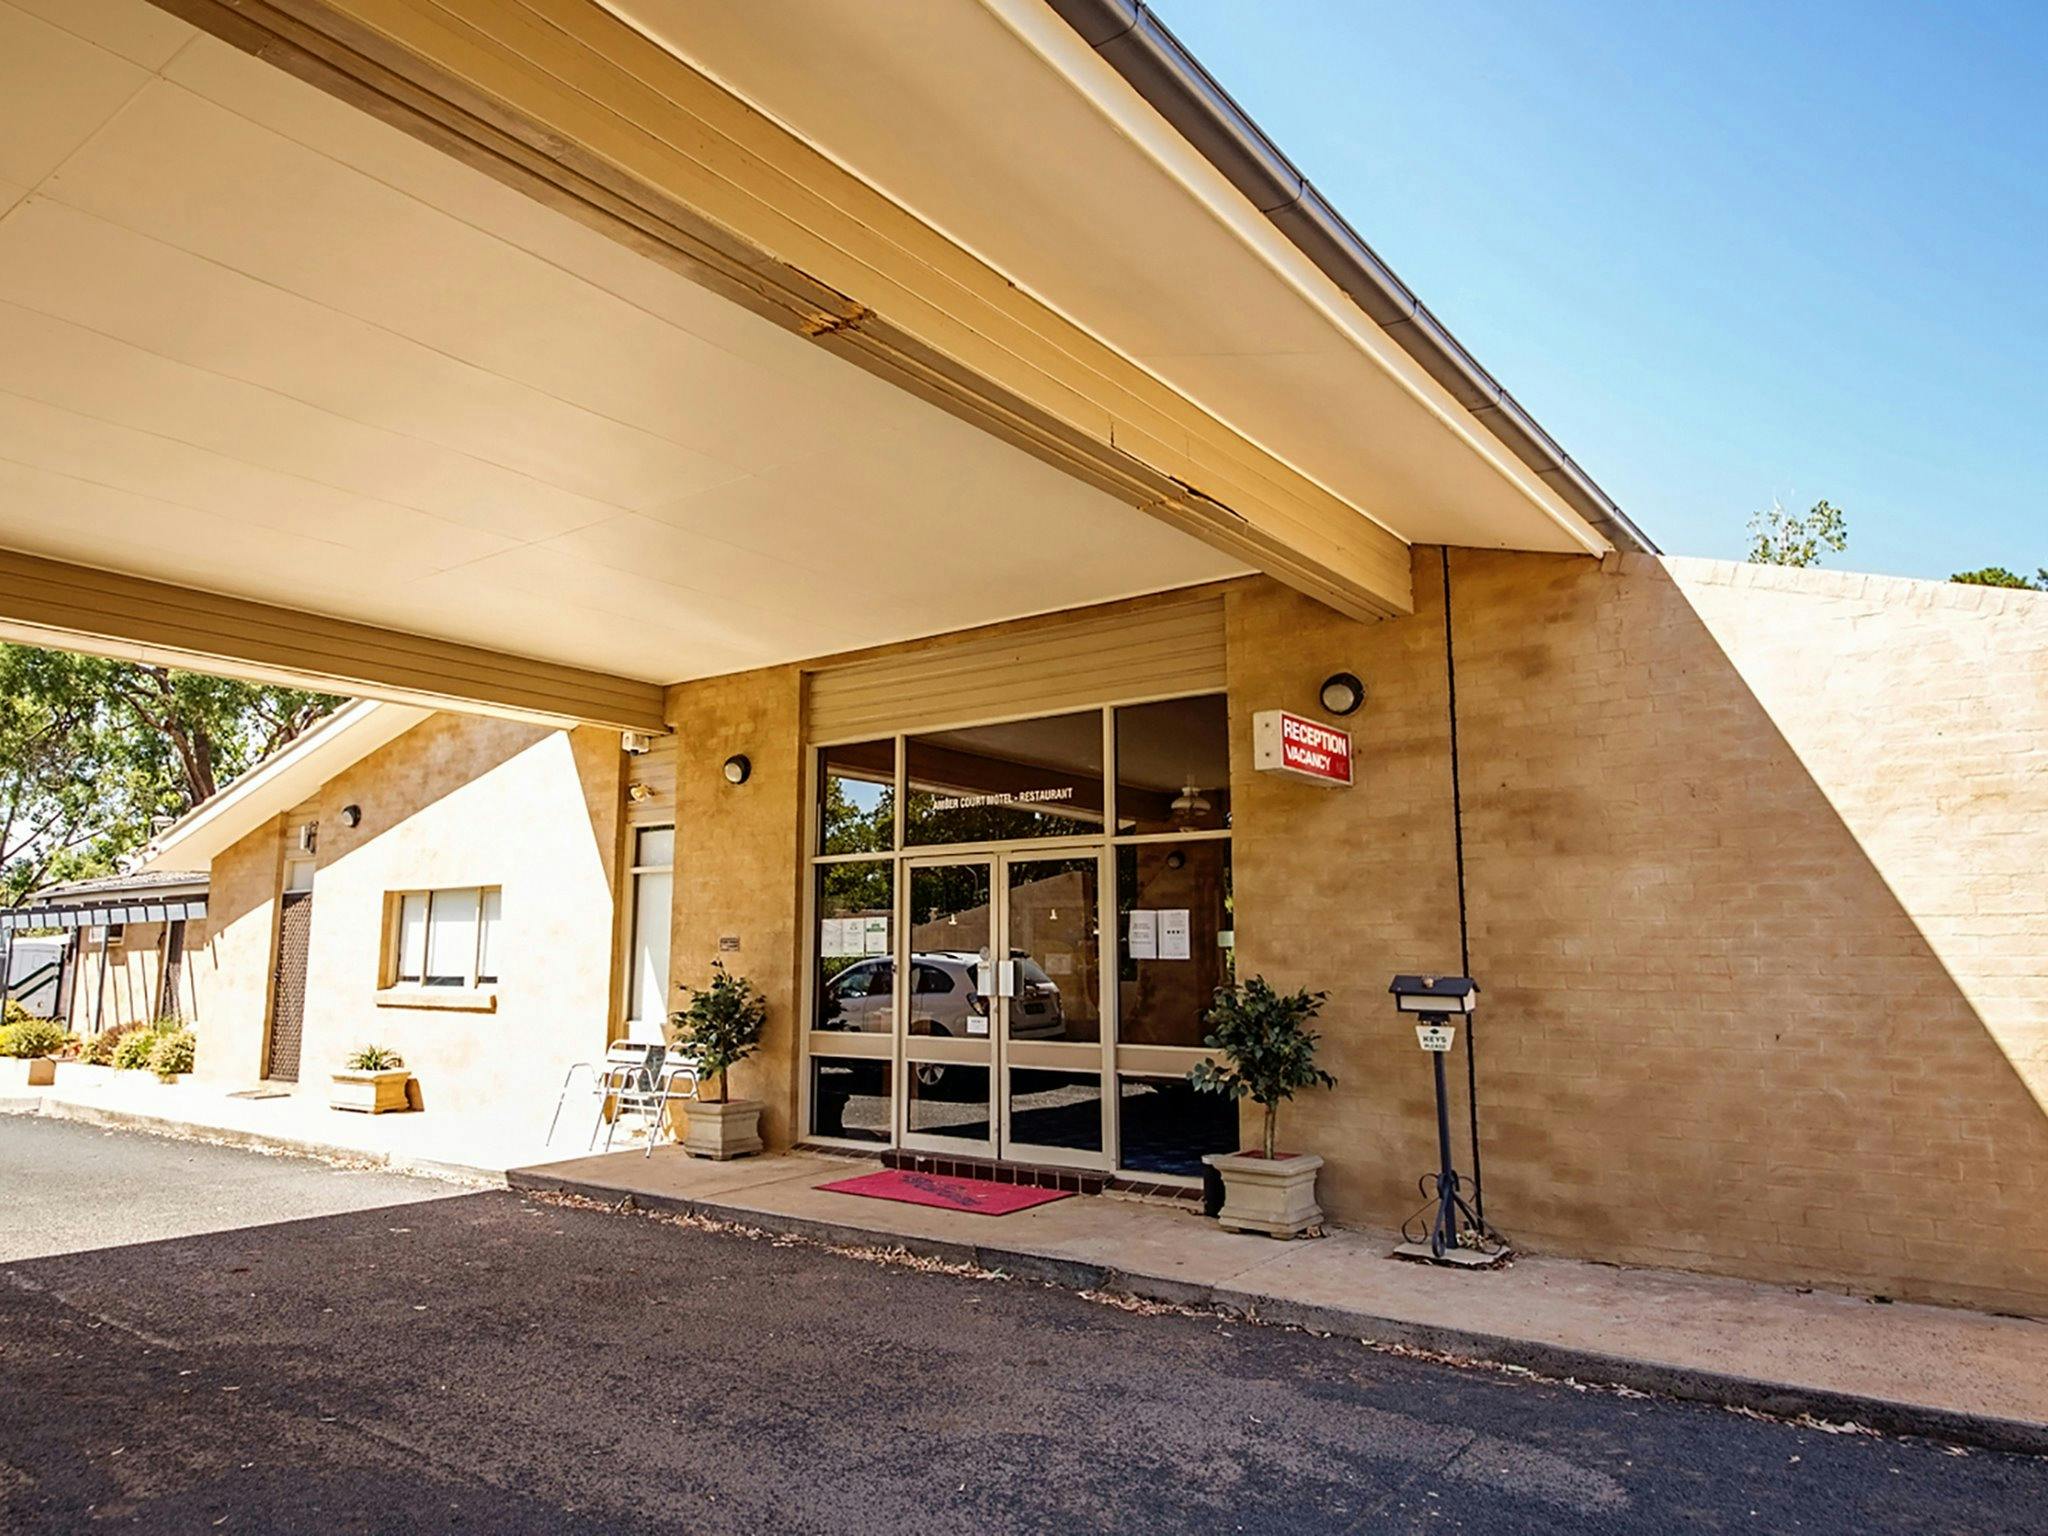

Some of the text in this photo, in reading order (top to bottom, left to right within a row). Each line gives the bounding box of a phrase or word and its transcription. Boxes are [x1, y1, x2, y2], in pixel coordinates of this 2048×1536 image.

[1283, 718, 1347, 757] RECEPTION
[1285, 743, 1332, 771] VACANCY
[933, 798, 959, 810] AMBER
[960, 796, 986, 808] COURT
[986, 793, 1013, 806] MOTEL
[1019, 787, 1073, 802] RESTAURANT
